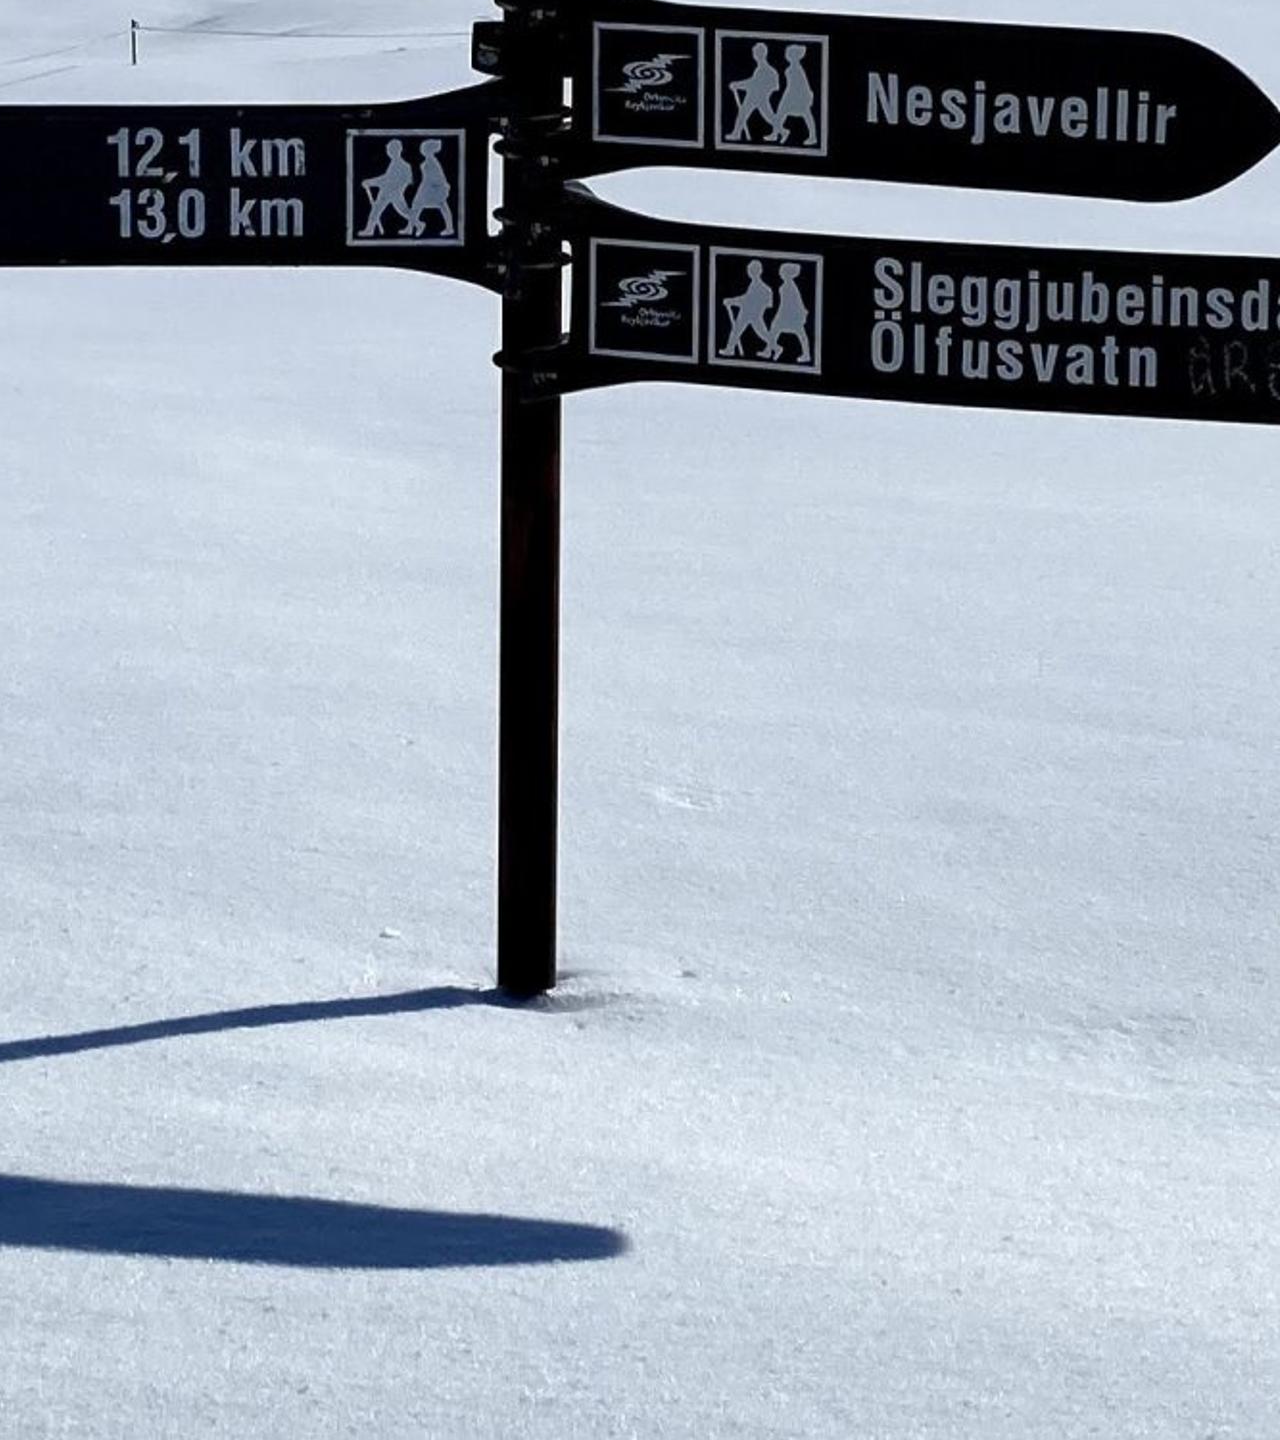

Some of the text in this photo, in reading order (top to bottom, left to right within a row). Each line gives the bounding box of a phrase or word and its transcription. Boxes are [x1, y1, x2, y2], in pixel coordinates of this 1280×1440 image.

[866, 72, 1177, 145] Nesjavellir
[107, 127, 200, 184] 12,1
[230, 127, 306, 177] km
[109, 188, 206, 246] 13,0
[230, 187, 304, 236] km
[871, 306, 1157, 387] Ölfusvatn
